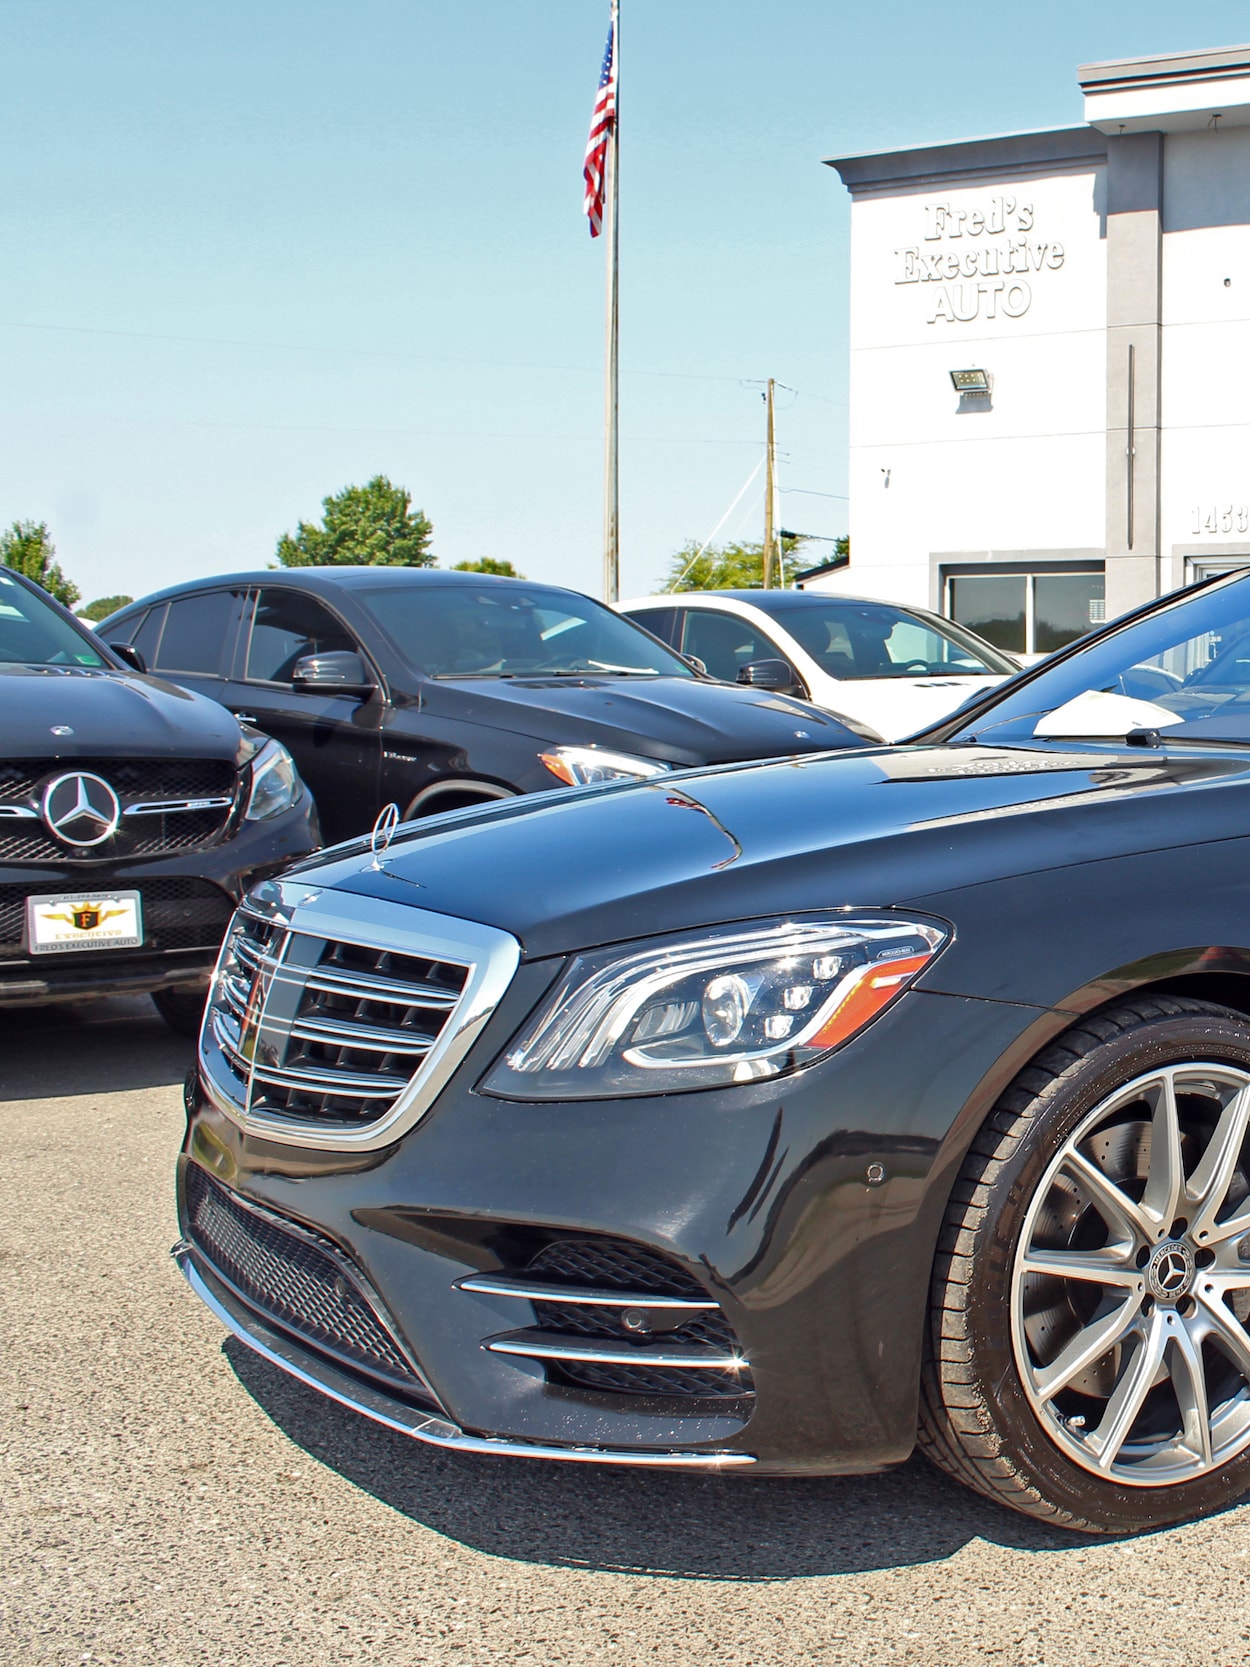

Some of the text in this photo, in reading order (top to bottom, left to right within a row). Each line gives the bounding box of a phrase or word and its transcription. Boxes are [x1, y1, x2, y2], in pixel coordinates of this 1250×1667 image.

[924, 195, 1034, 241] Fred's
[894, 236, 1065, 285] Executive
[926, 278, 1033, 324] AUTO
[66, 939, 111, 950] EXECUTIVE
[113, 937, 138, 946] AUTO
